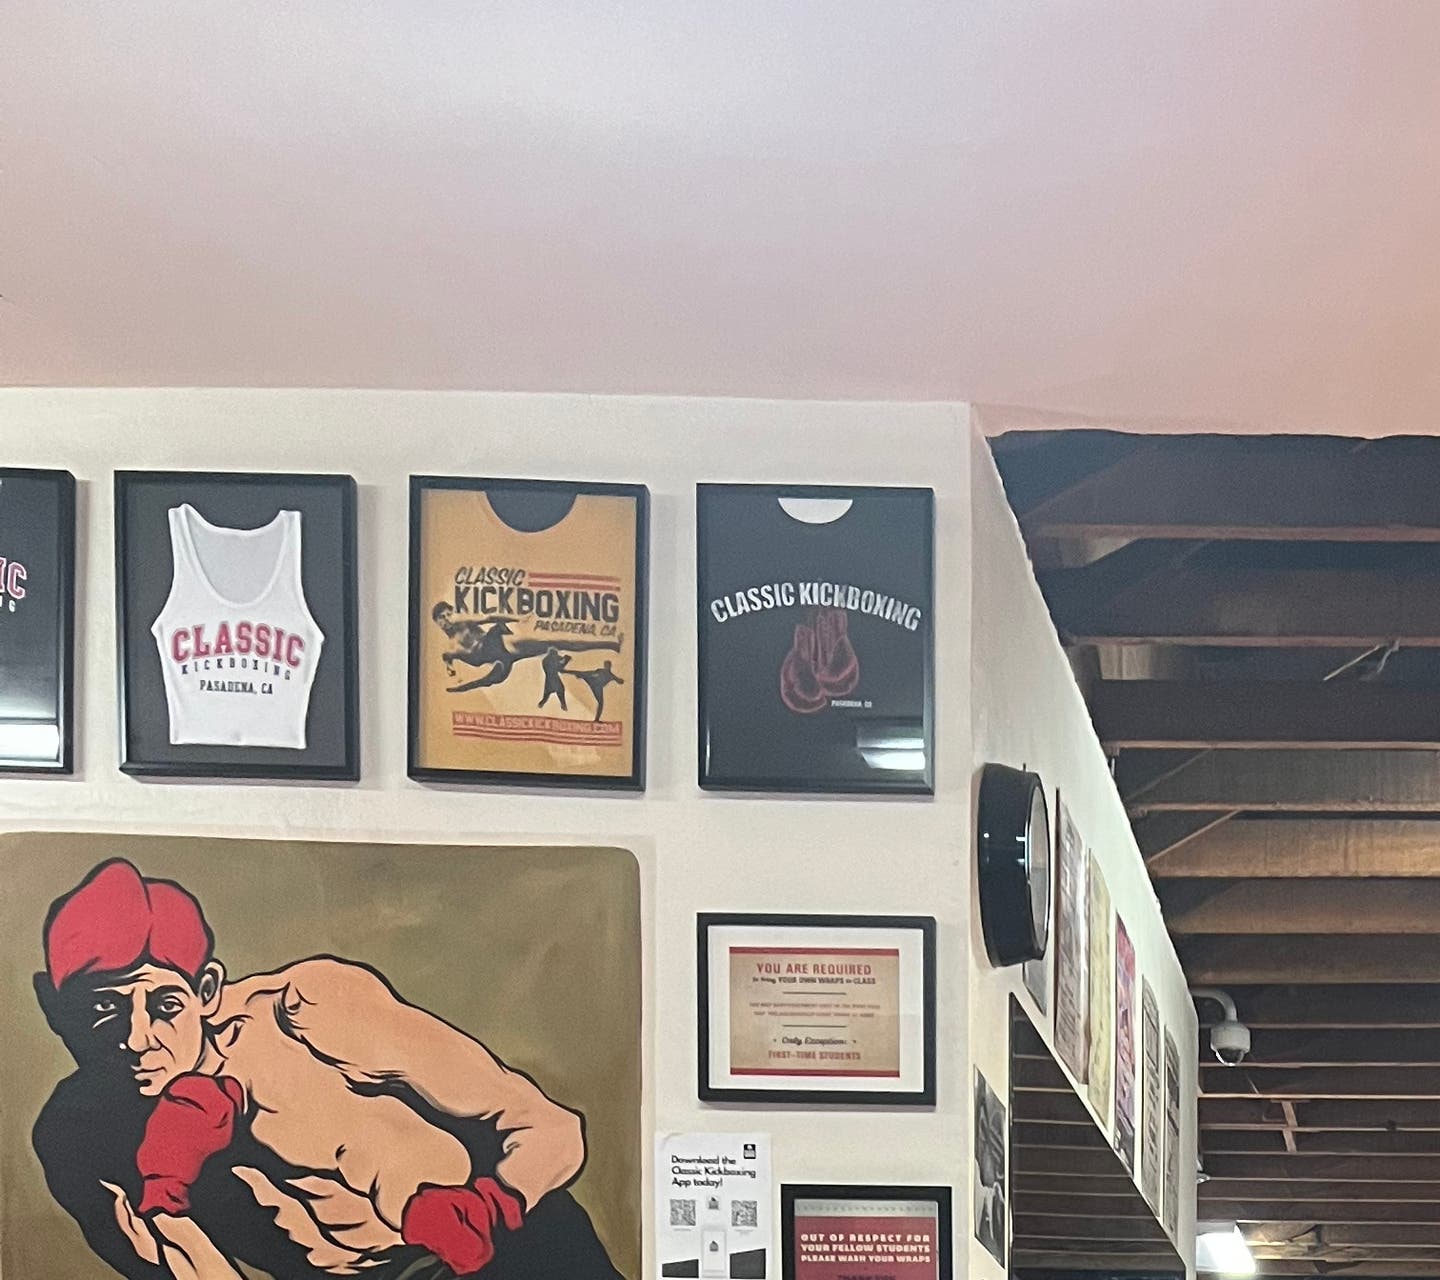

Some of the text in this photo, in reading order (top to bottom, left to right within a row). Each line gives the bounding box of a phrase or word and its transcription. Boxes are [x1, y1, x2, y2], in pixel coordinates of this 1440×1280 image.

[455, 566, 526, 586] CLASSIC
[0, 595, 16, 612] G
[454, 586, 620, 623] KICKBOXING
[710, 582, 922, 631] CLASSIC KICKBOXING
[171, 620, 305, 669] CLASSIC
[181, 657, 291, 681] KICKBOXING
[757, 963, 872, 975] YOU ARE REQUIRED
[801, 1234, 930, 1243] OUT OF RESPECT FOR
[801, 1244, 930, 1253] YOUR FELLOW STUDENTS
[800, 1255, 836, 1263] PLEASE
[868, 1255, 894, 1263] YOUR
